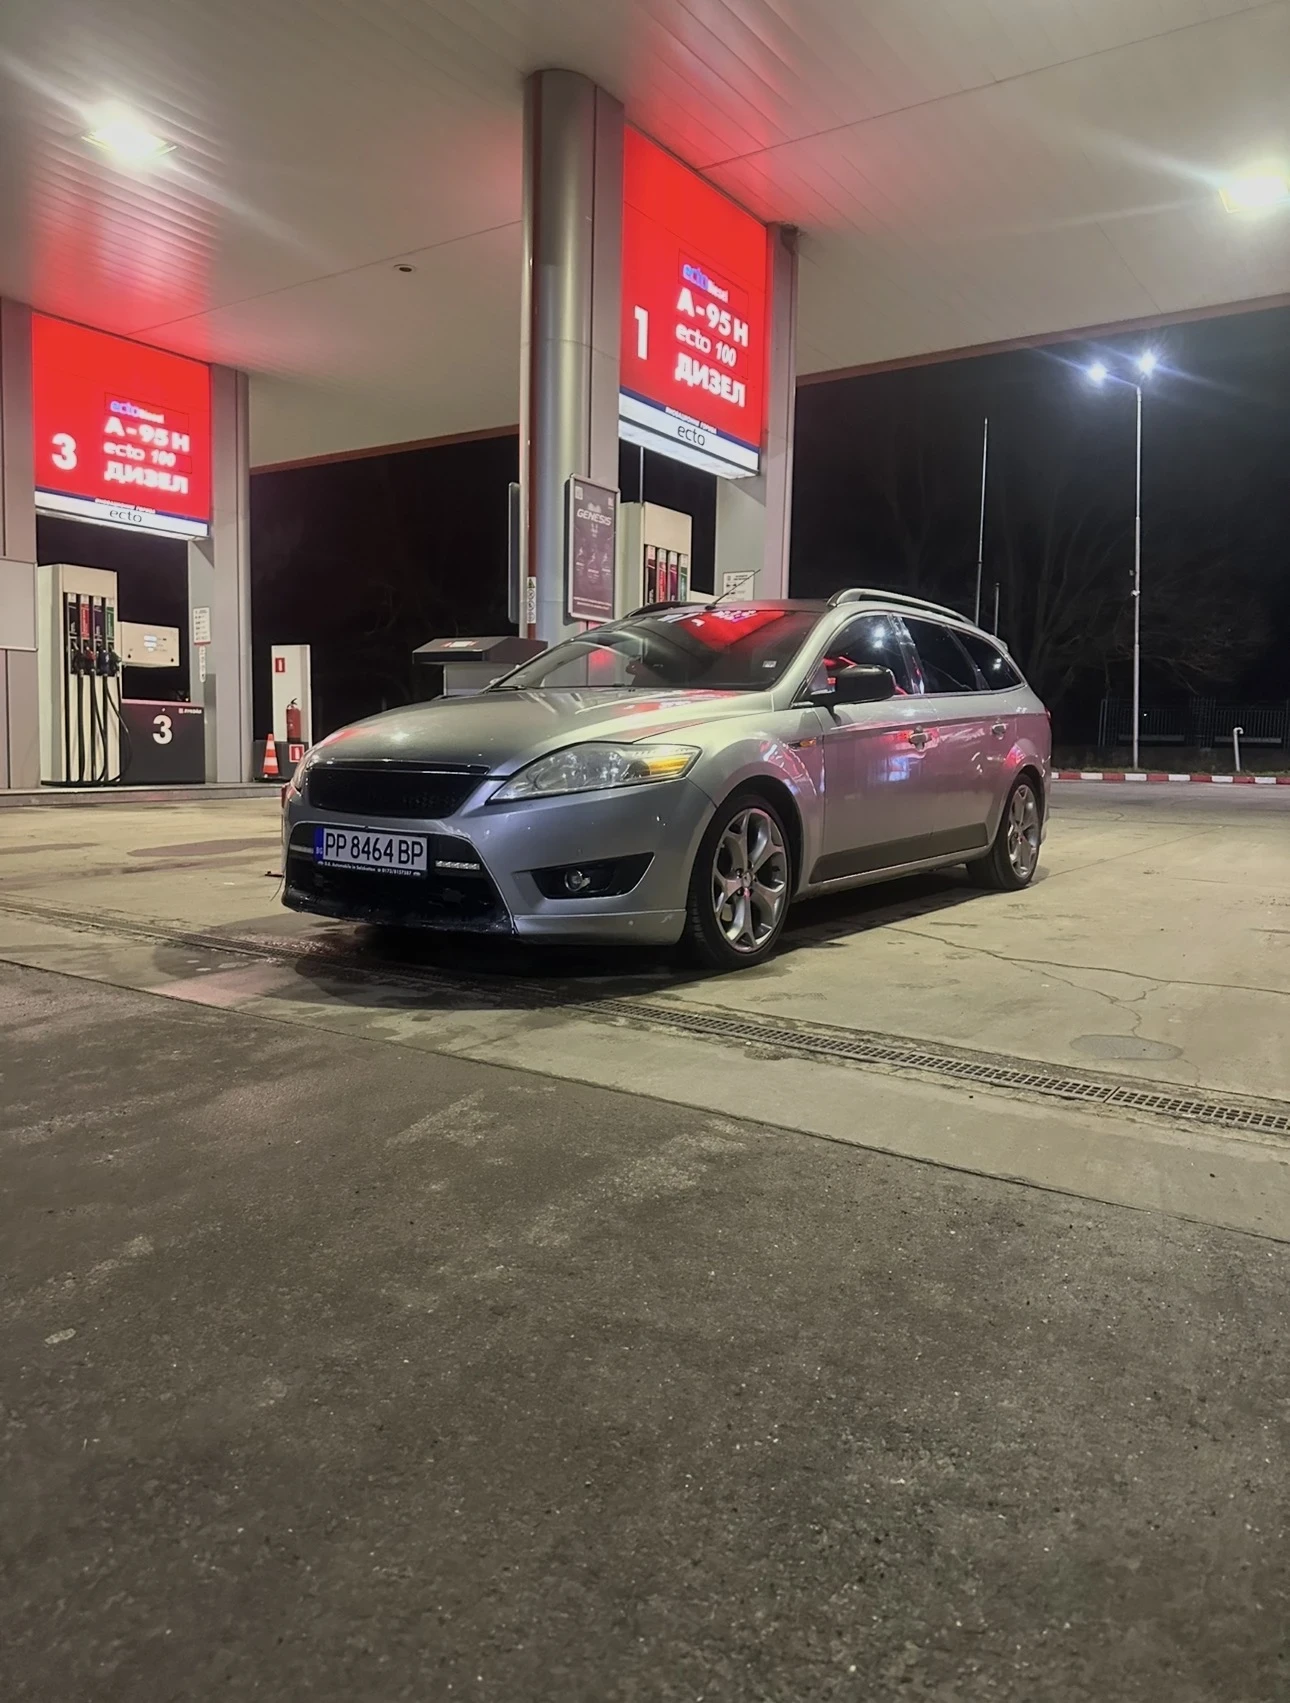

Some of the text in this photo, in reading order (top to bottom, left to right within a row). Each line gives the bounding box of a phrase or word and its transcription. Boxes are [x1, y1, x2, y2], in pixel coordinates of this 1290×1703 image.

[634, 305, 649, 361] 1
[675, 322, 737, 368] ecto 100
[674, 351, 747, 408] ДИЗЕЛ
[51, 432, 78, 471] 3
[677, 425, 706, 446] ecto
[103, 440, 177, 468] ecto 100
[103, 460, 189, 494] ДИЗЕЛ
[109, 509, 143, 523] ecto
[576, 509, 612, 526] GENESIS
[152, 714, 173, 745] 3
[325, 832, 424, 865] PP 8464 BP
